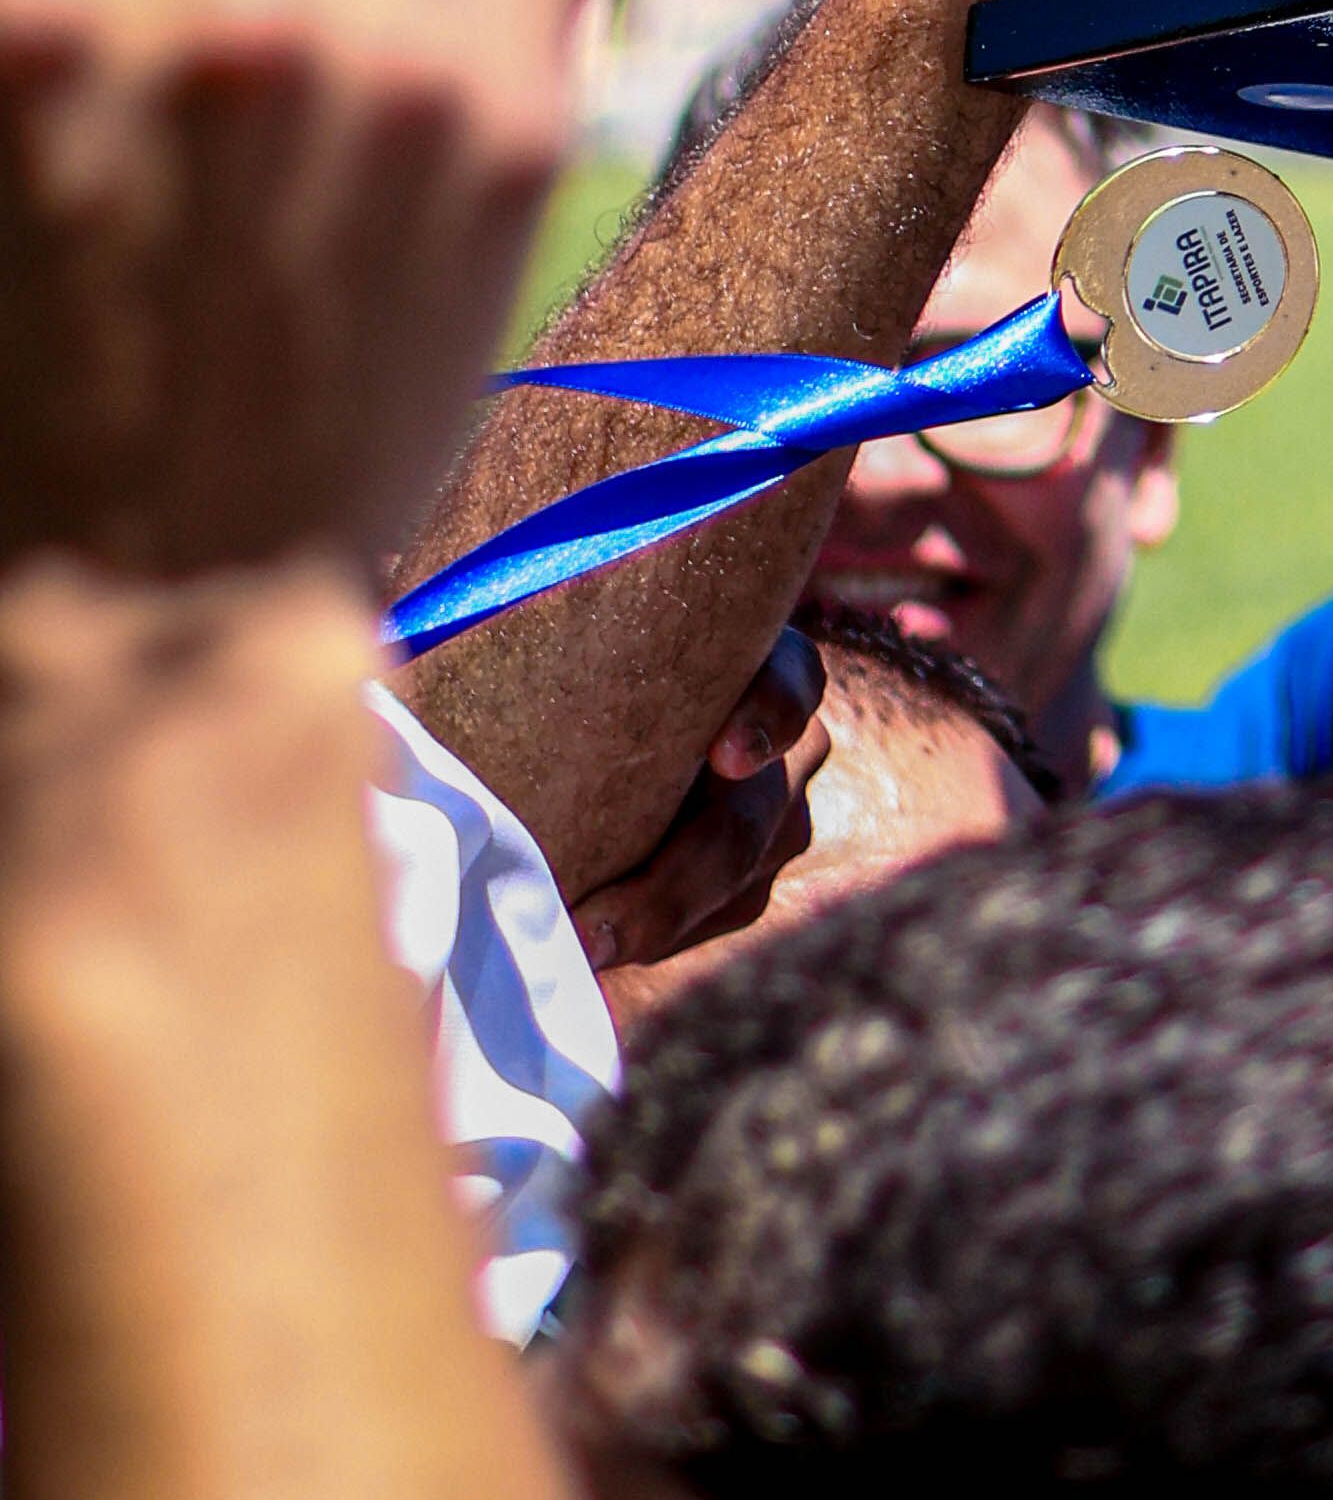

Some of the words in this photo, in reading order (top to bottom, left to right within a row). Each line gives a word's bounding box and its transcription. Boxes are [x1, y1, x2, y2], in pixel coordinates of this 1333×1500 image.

[1216, 230, 1229, 245] DE
[1225, 209, 1246, 243] LAZER
[1238, 243, 1249, 252] E
[1176, 228, 1232, 331] ITAPIRA
[1222, 245, 1252, 305] SECRETARIA
[1242, 252, 1270, 307] ESPORTES
